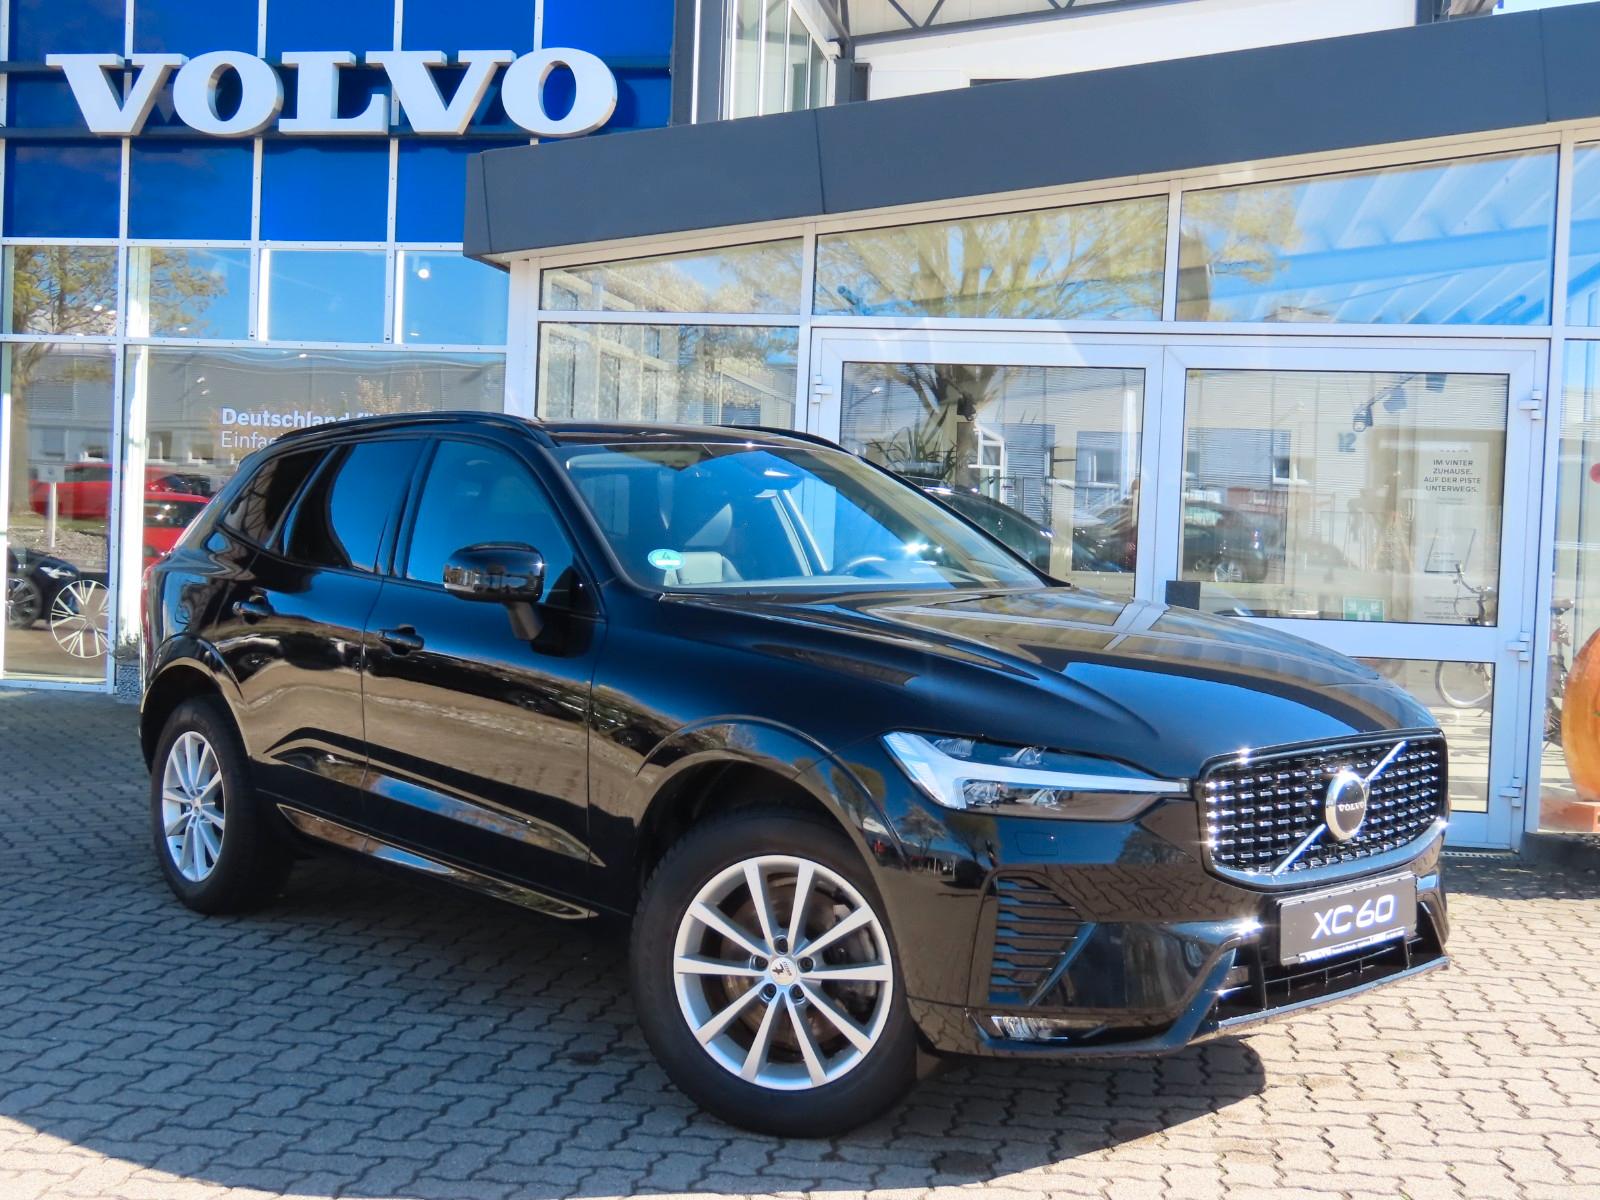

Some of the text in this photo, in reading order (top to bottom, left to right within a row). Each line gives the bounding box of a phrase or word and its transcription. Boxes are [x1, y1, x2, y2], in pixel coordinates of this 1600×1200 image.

[46, 47, 618, 138] VOLVO
[221, 430, 283, 449] Einfac
[1337, 801, 1365, 812] VOLVO
